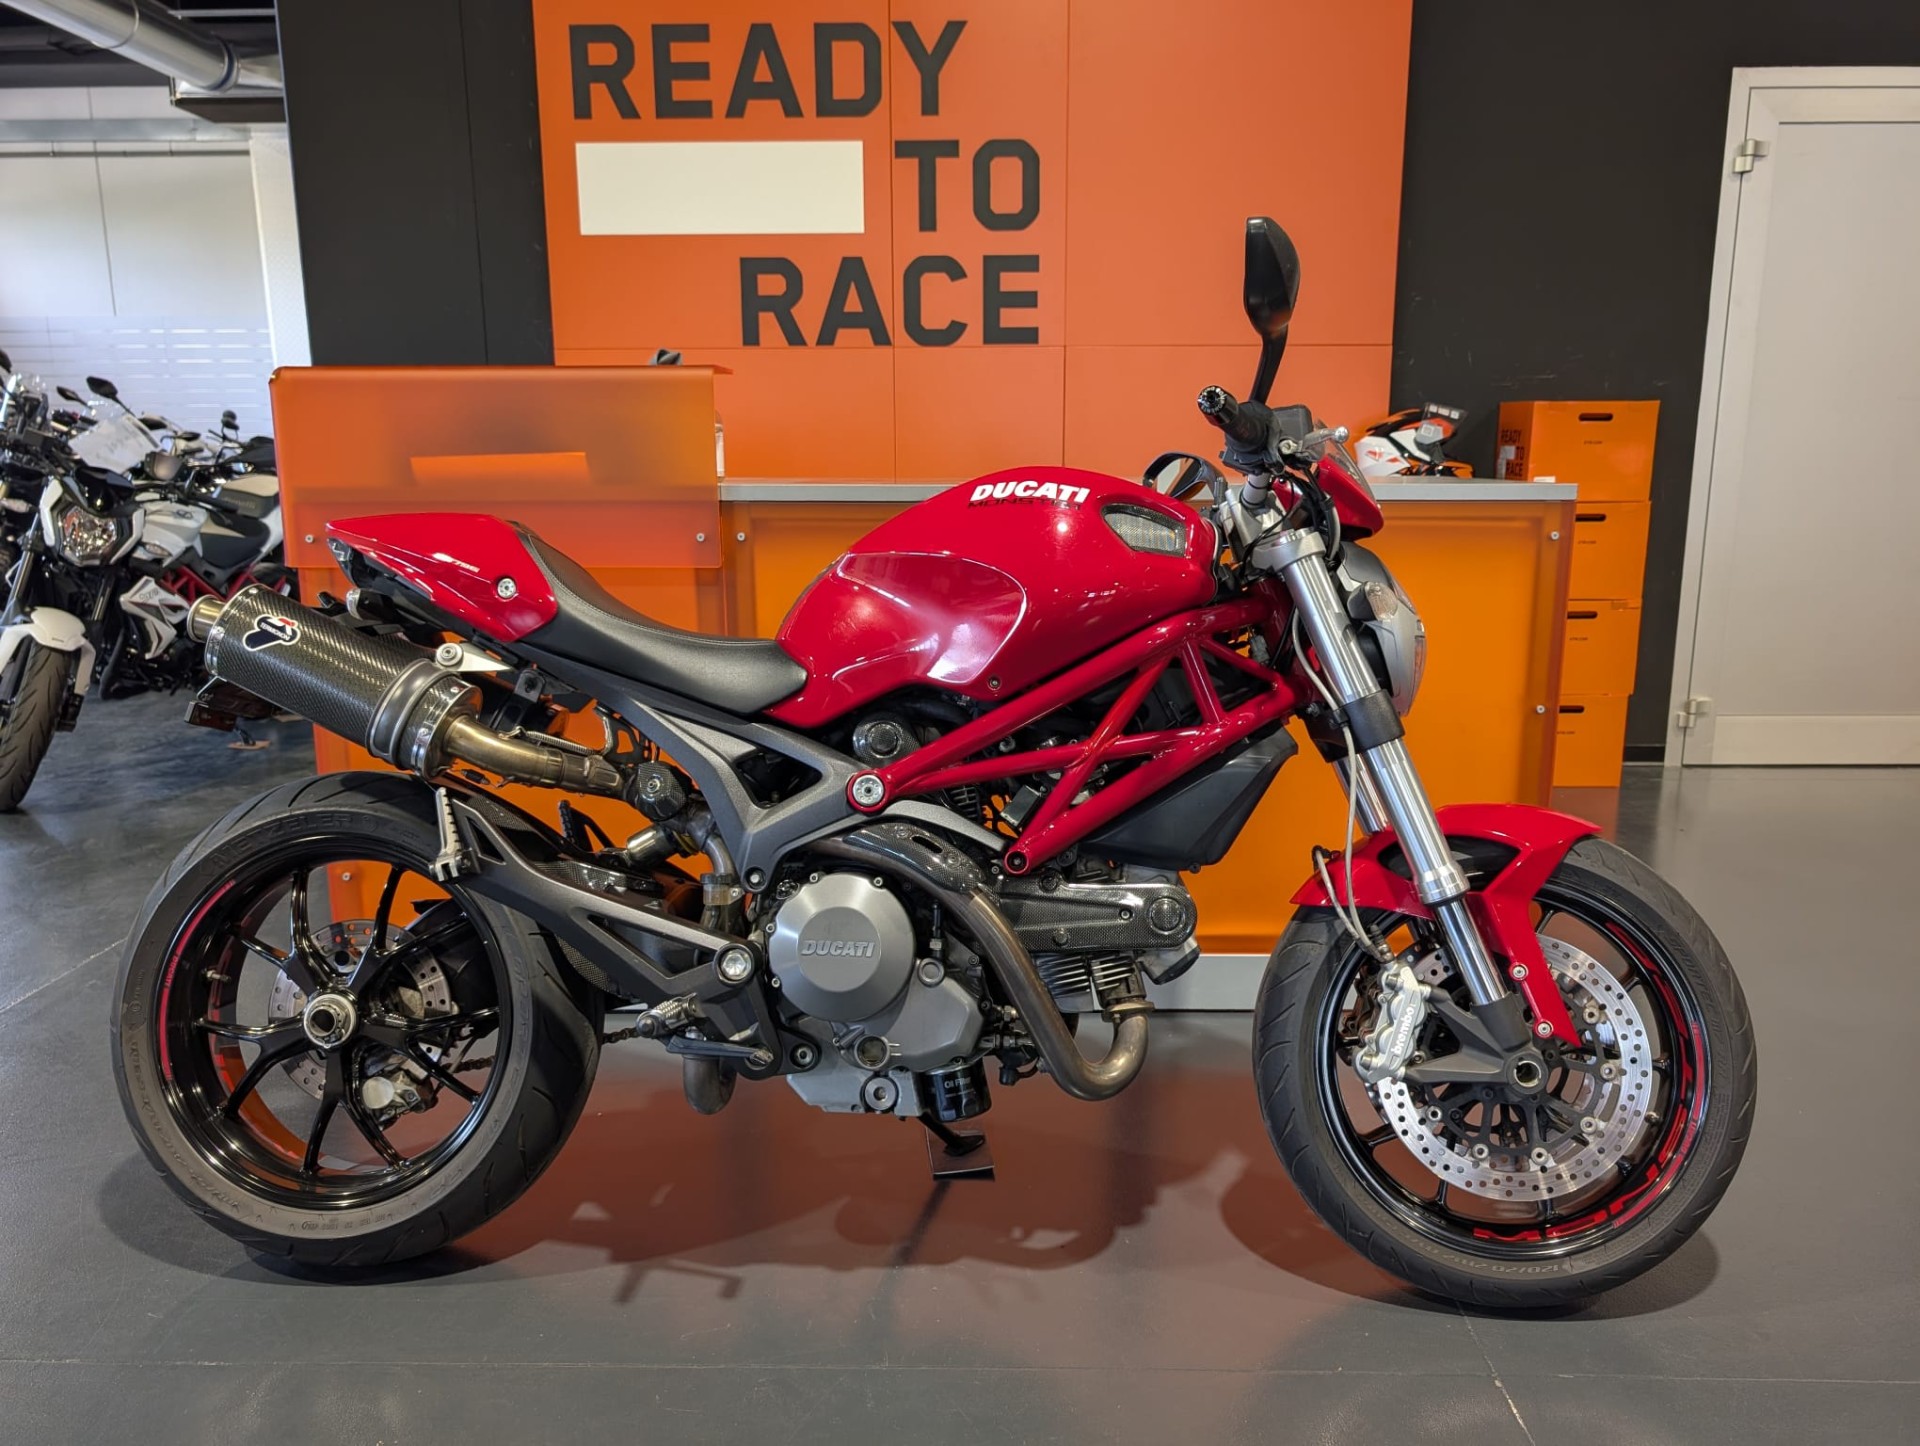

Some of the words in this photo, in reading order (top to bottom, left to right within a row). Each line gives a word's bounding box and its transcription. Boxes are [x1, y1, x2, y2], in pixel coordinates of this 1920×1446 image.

[569, 20, 968, 120] READY
[894, 139, 1040, 232] TO
[739, 255, 1040, 347] RACE
[1501, 429, 1522, 444] READY
[1516, 446, 1525, 460] TO
[1506, 462, 1523, 477] RACE
[969, 480, 1090, 503] DUCATI
[800, 940, 875, 958] DUCATI
[1391, 1006, 1415, 1056] brembo
